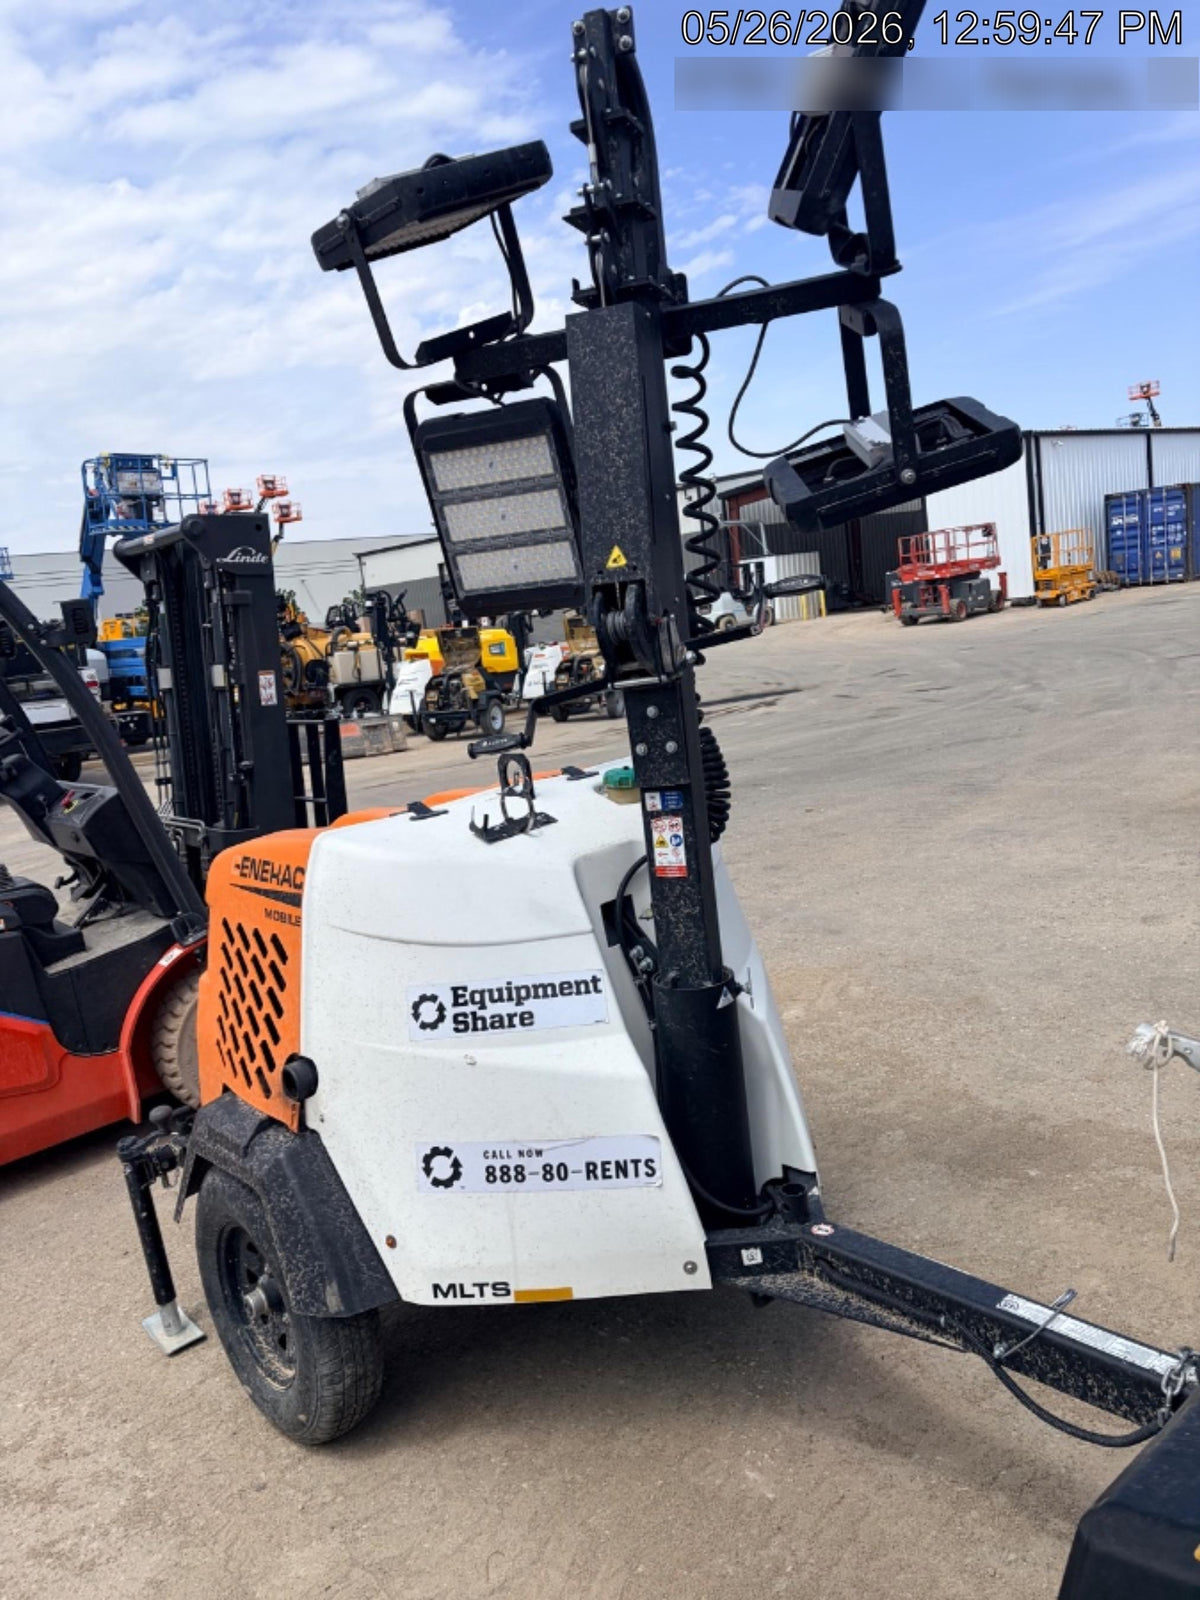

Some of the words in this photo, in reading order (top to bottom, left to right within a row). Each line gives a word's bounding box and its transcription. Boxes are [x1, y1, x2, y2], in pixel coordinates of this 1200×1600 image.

[216, 545, 269, 564] Linde
[264, 907, 302, 927] MOBILE
[451, 975, 602, 1010] Equipment
[452, 1010, 535, 1033] Share
[483, 1150, 512, 1160] CALL
[518, 1149, 543, 1159] NOW
[485, 1158, 657, 1184] 888-80-RENTS
[432, 1281, 511, 1299] MLTS
